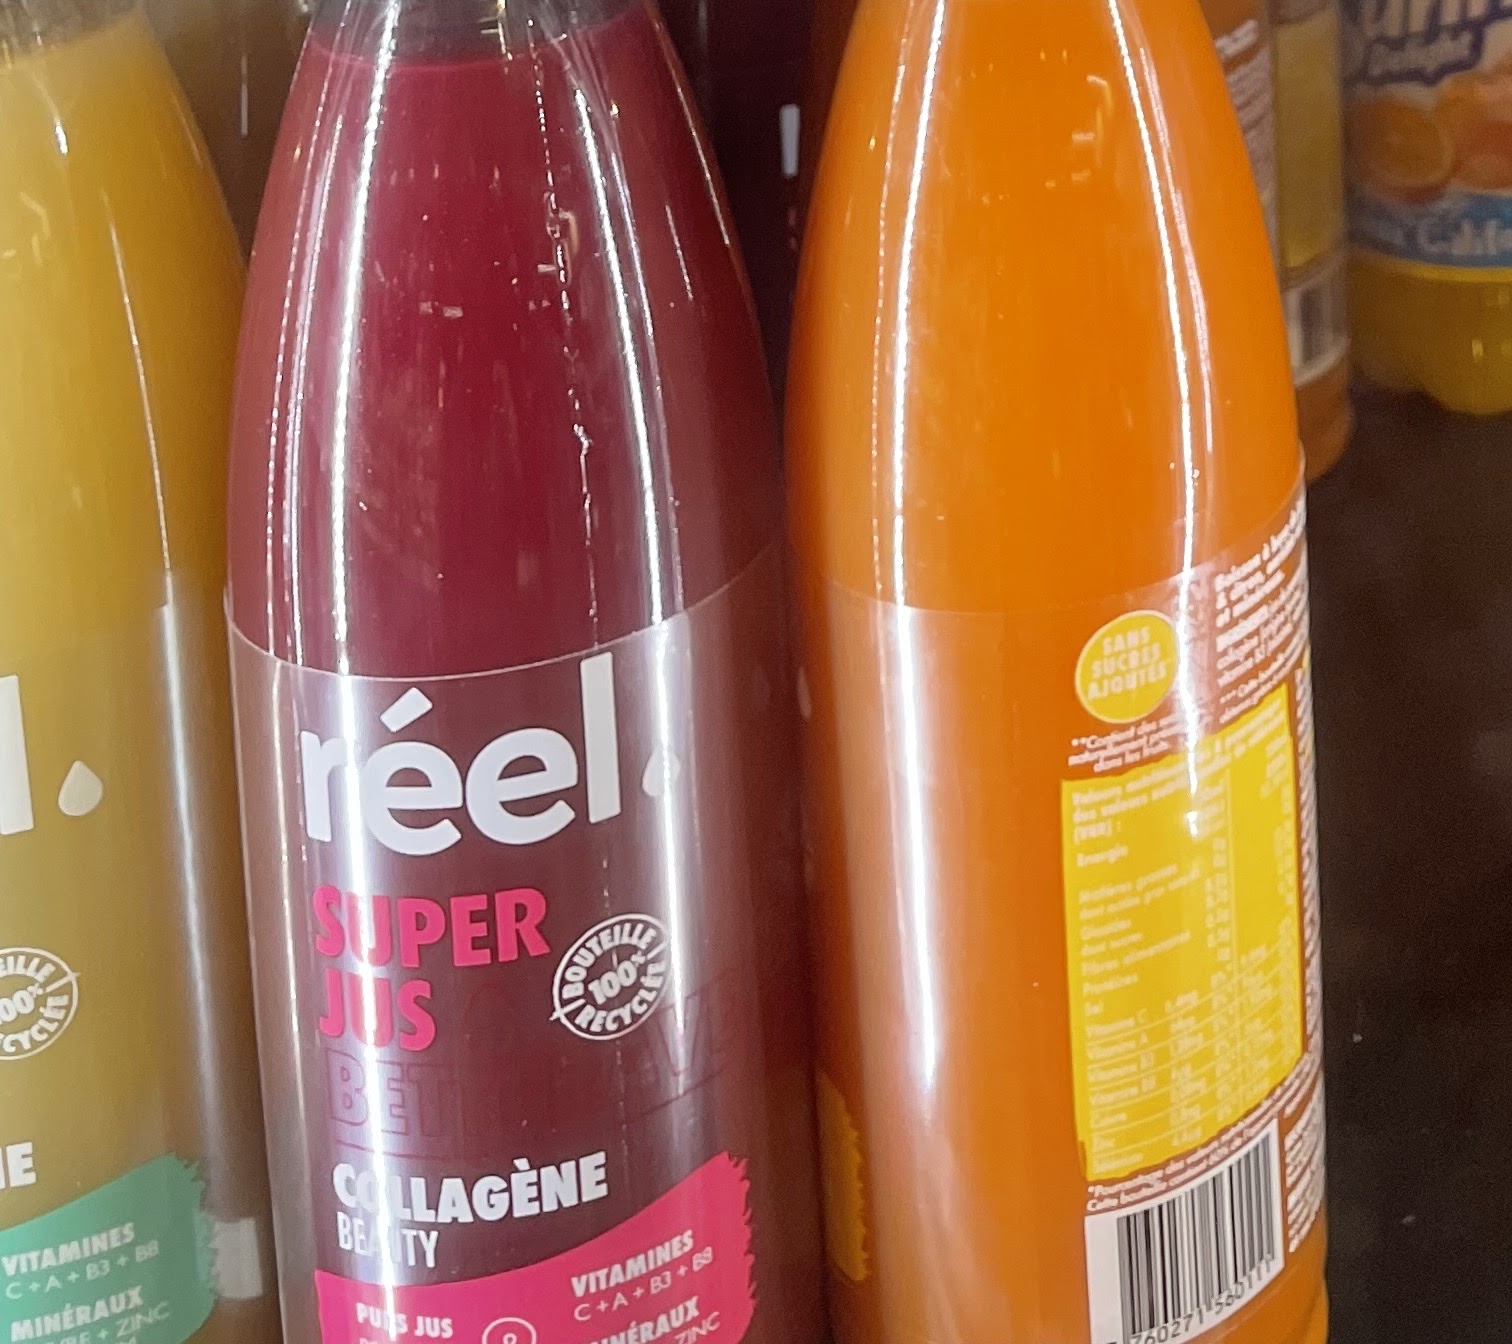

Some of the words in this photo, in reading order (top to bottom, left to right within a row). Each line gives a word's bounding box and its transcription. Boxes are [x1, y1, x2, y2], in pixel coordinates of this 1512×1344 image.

[1091, 642, 1161, 679] SUCRES
[1102, 626, 1150, 656] SANS
[299, 652, 622, 856] réel
[312, 884, 551, 969] SUPER
[562, 922, 657, 1000] BOUTEILLE
[318, 966, 437, 1053] JUS
[332, 1150, 610, 1224] COLLAGÈNE
[1, 1222, 136, 1278] VITAMINES
[336, 1210, 440, 1269] BEATY
[571, 1228, 695, 1298] VITAMINES
[5, 1281, 23, 1300] C
[44, 1269, 63, 1293] A
[86, 1260, 111, 1281] B3
[574, 1303, 592, 1322] C
[612, 1292, 629, 1311] A
[650, 1271, 672, 1294] B3
[11, 1284, 144, 1343] MINÉRAUX
[414, 1315, 454, 1339] JUS
[588, 1295, 701, 1344] INÉRAUX
